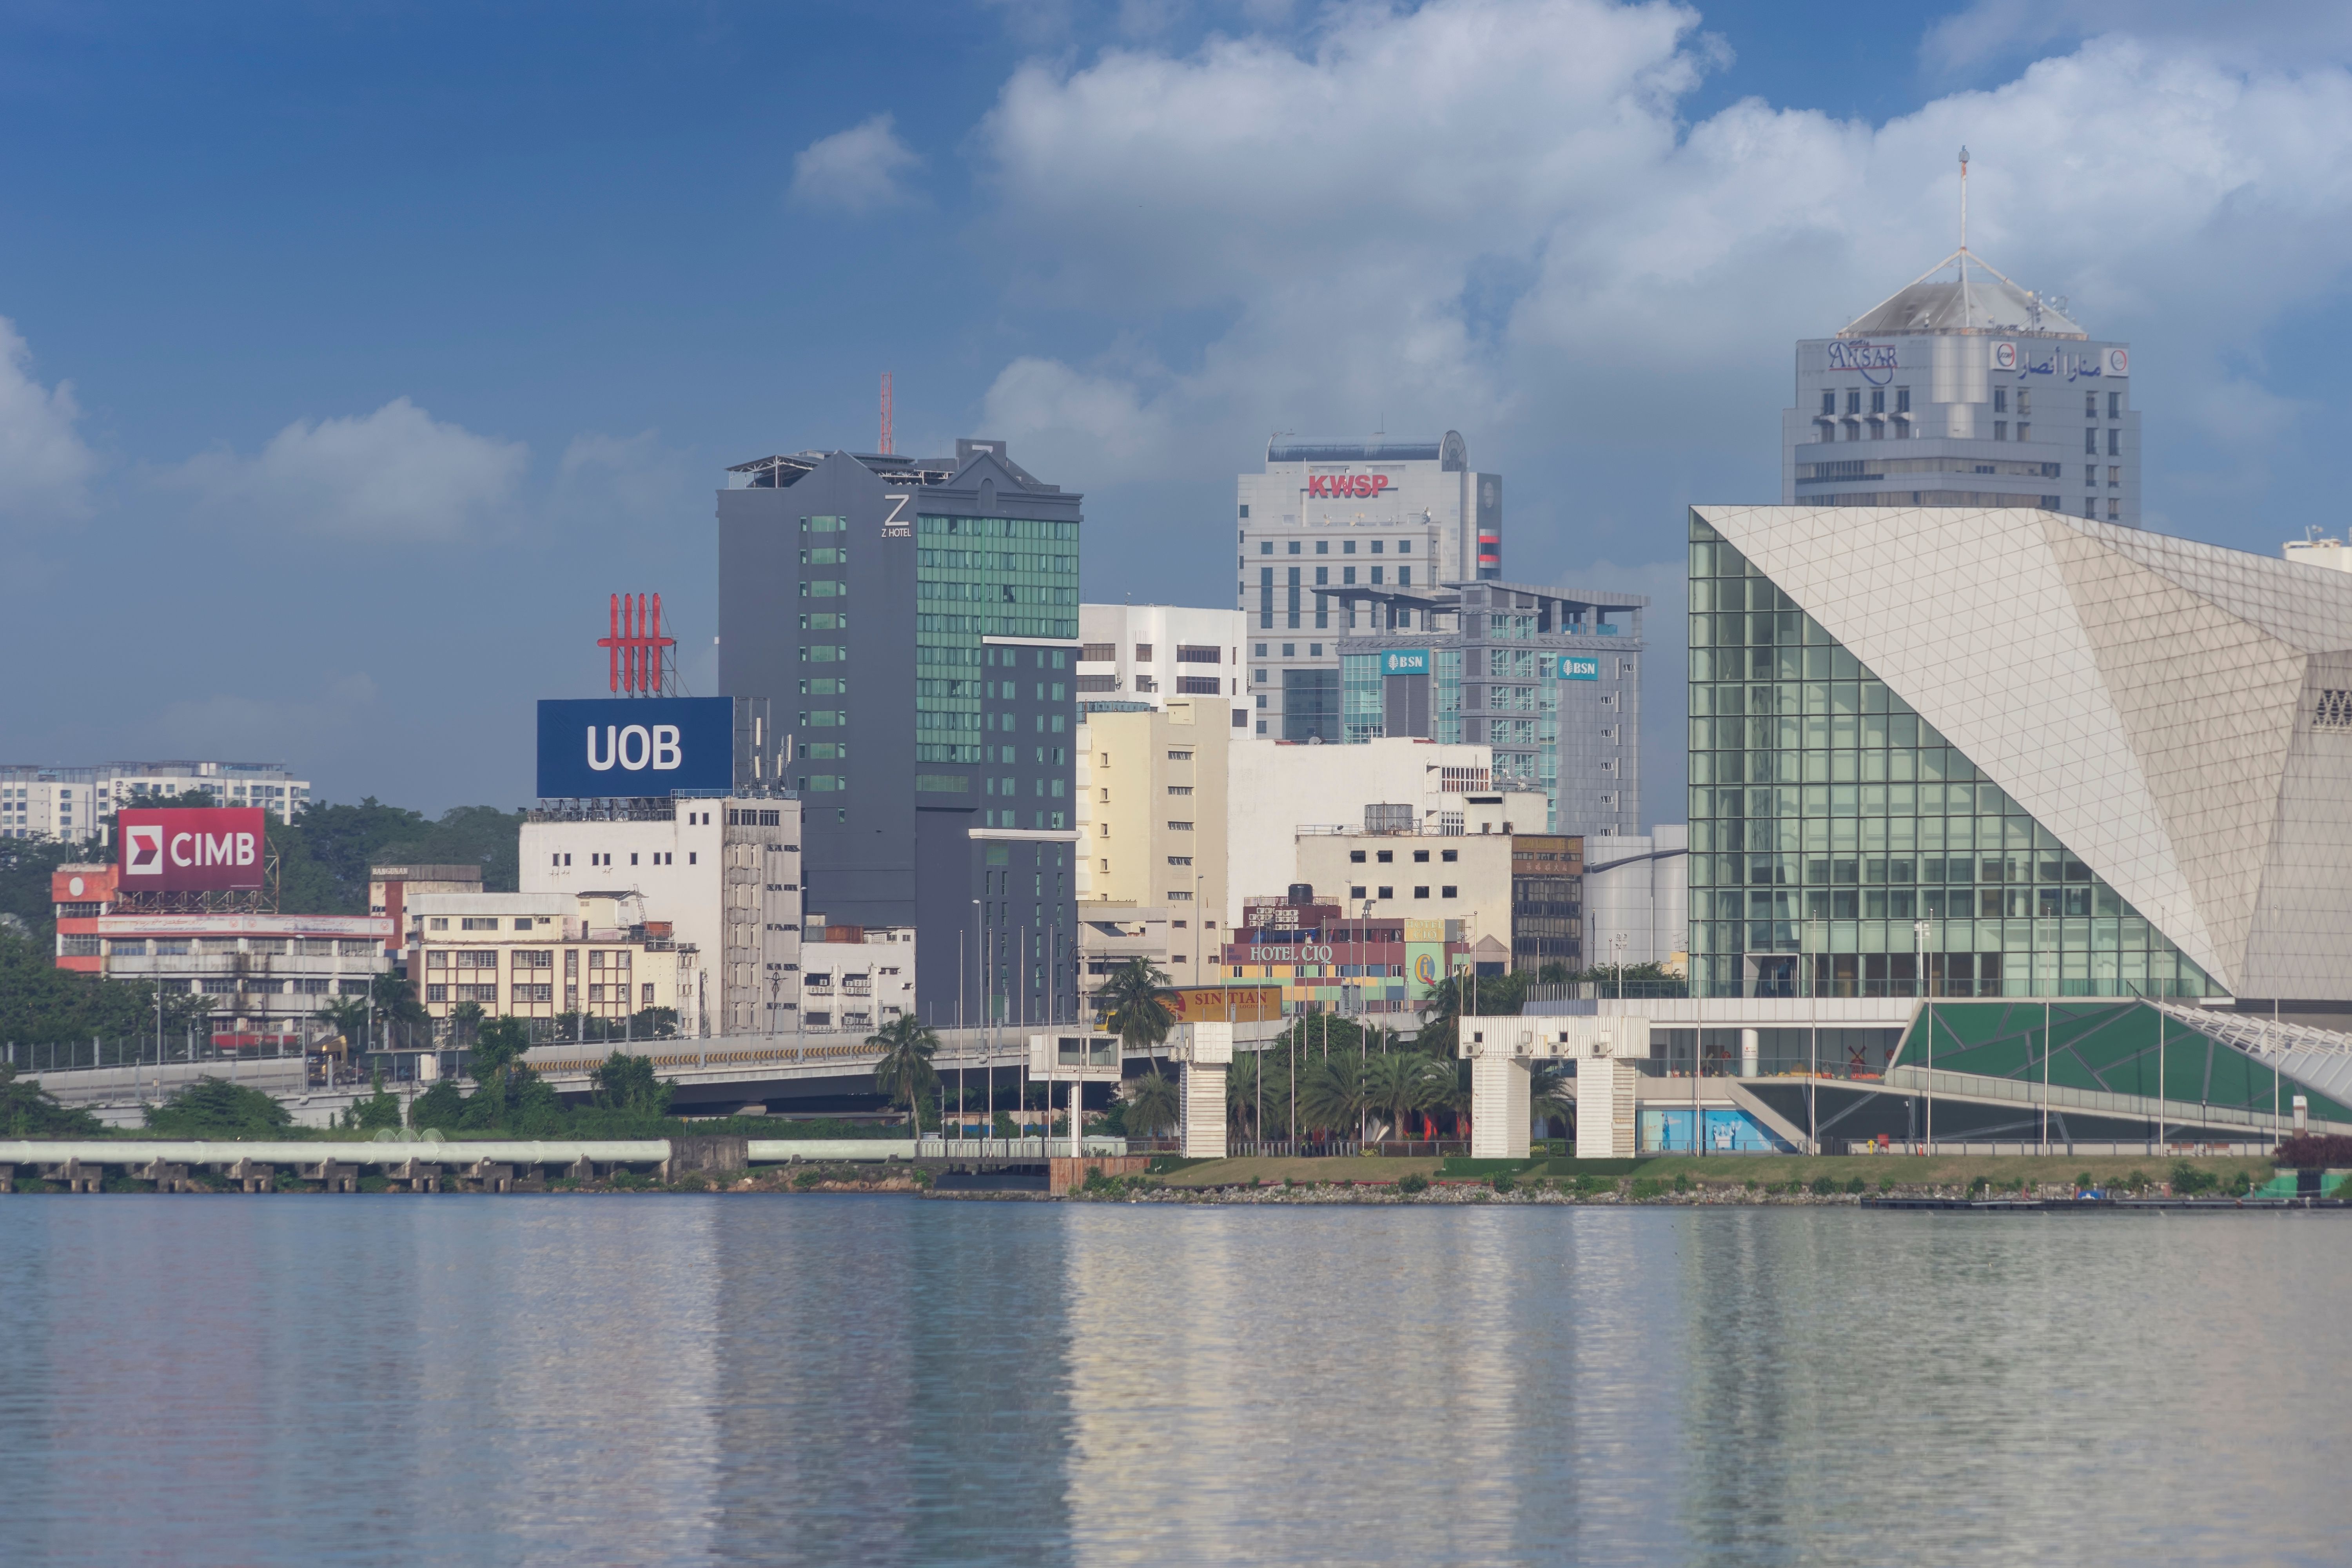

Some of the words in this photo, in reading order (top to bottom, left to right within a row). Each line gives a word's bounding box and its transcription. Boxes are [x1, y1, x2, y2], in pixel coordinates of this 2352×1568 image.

[1829, 342, 1898, 370] ANSAR
[1309, 474, 1388, 498] KWSP
[884, 494, 909, 526] Z
[881, 528, 887, 537] Z
[889, 528, 911, 537] HOTEL
[1400, 656, 1423, 668] BSN
[1573, 662, 1595, 675] BSN
[587, 724, 682, 771] UOB
[170, 832, 254, 867] CIMB
[1414, 930, 1437, 941] CIQ
[1250, 947, 1298, 961] HOTEL
[1301, 946, 1332, 964] CIQ
[1195, 993, 1221, 1005] SIN
[1227, 992, 1267, 1004] TIAN
